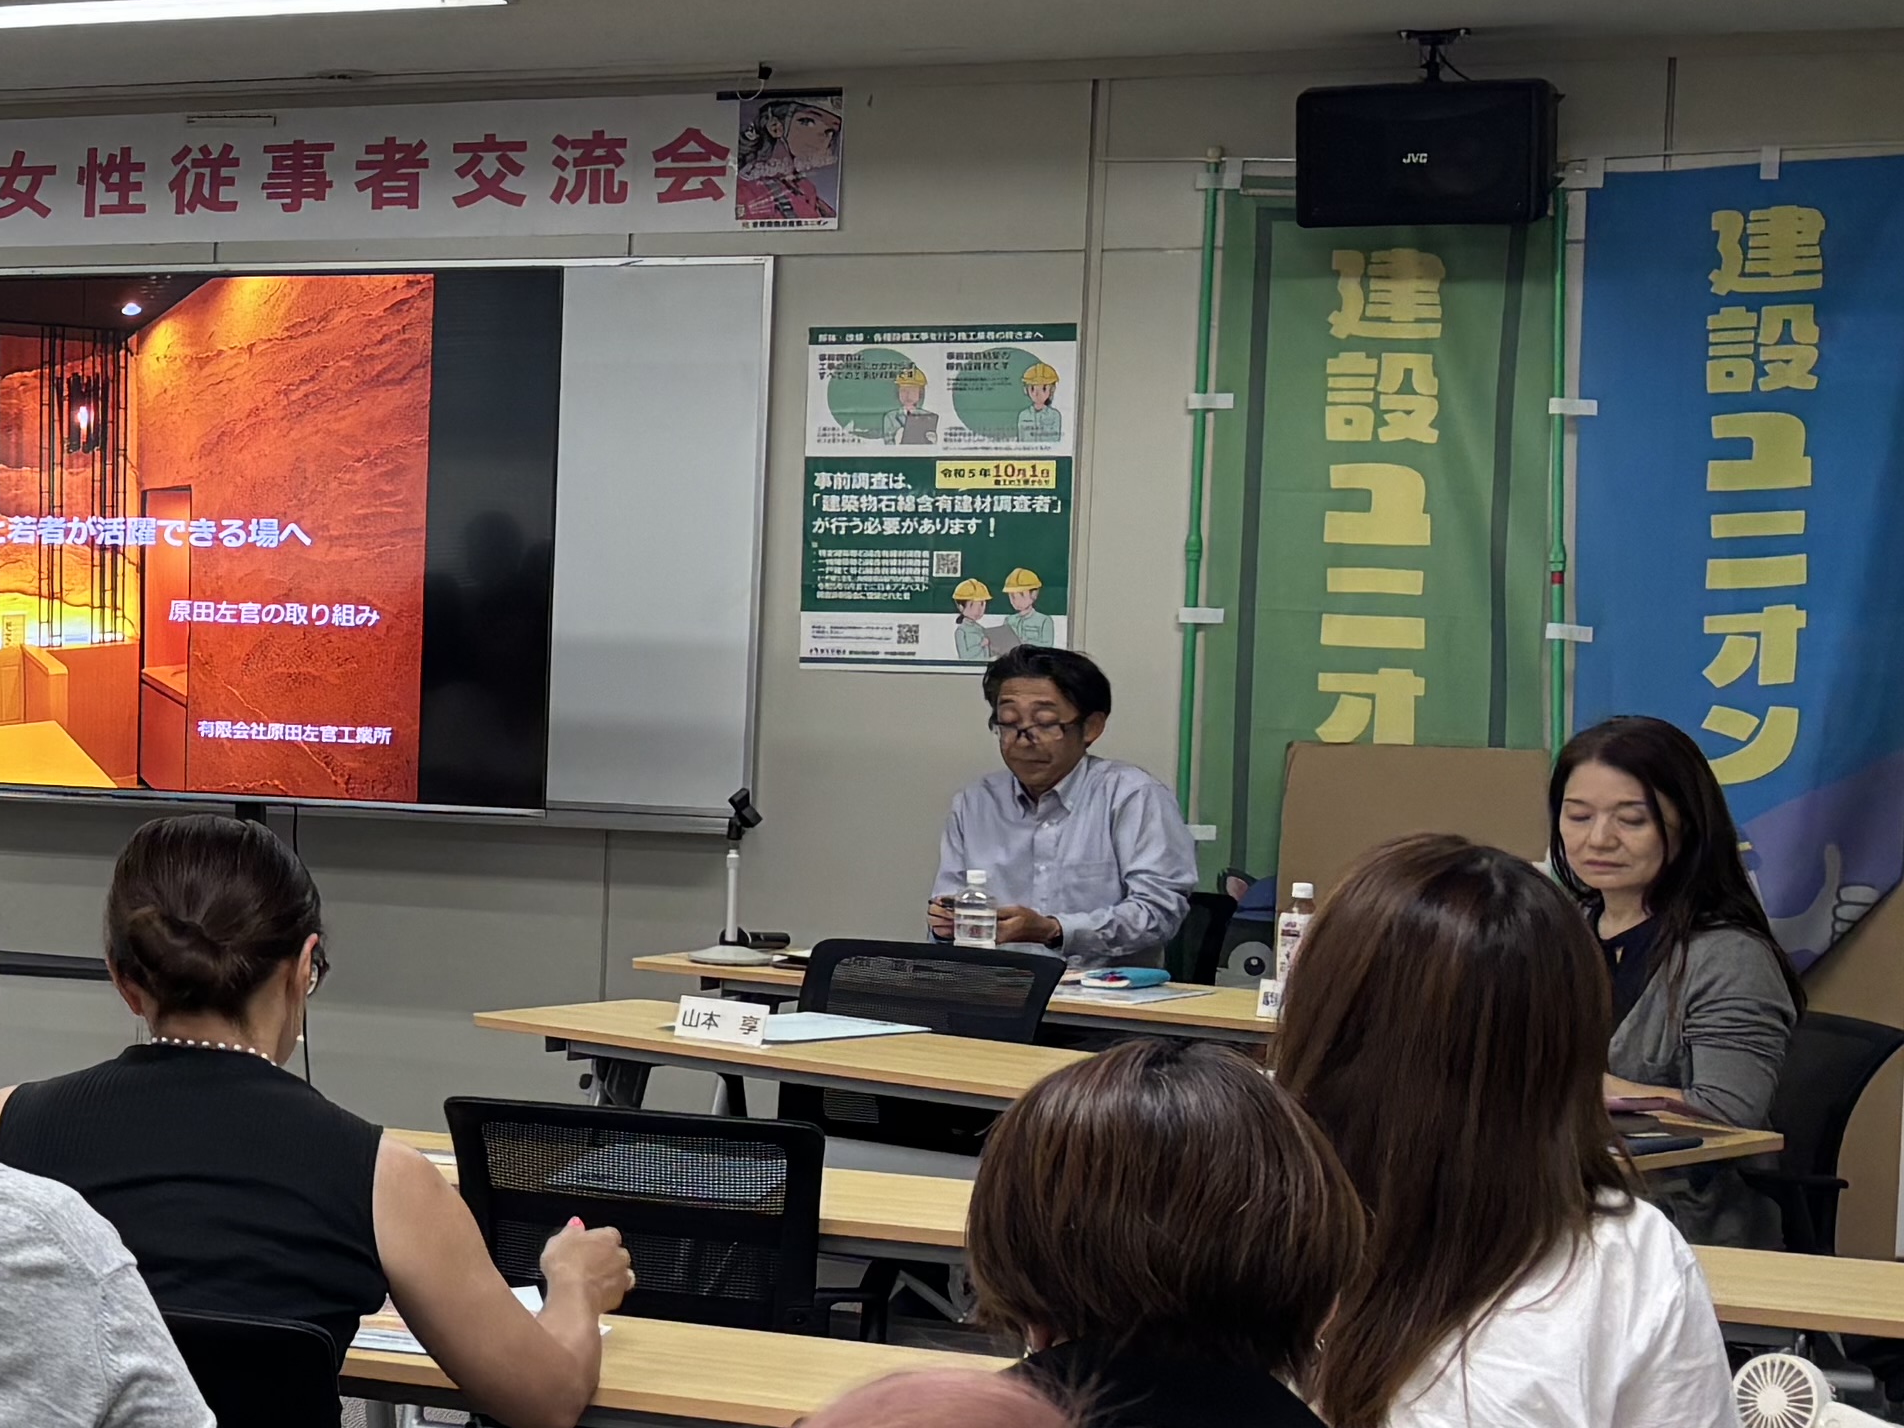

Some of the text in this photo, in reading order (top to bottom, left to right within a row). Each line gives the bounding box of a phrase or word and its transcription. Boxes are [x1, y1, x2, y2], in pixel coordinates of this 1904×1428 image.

[1402, 153, 1428, 164] JVC
[814, 472, 913, 490] 事前調査は、
[812, 494, 1062, 514] 「建築物石綿含有建材調査者」
[1315, 247, 1446, 746] 建設ユニオ
[1702, 204, 1826, 786] 建設ユニオン
[812, 517, 995, 538] が行う必要があります！
[169, 599, 380, 628] 原田左官の取り組み
[197, 719, 393, 746] 有限会社原田左官工業所
[682, 1008, 721, 1031] 山本
